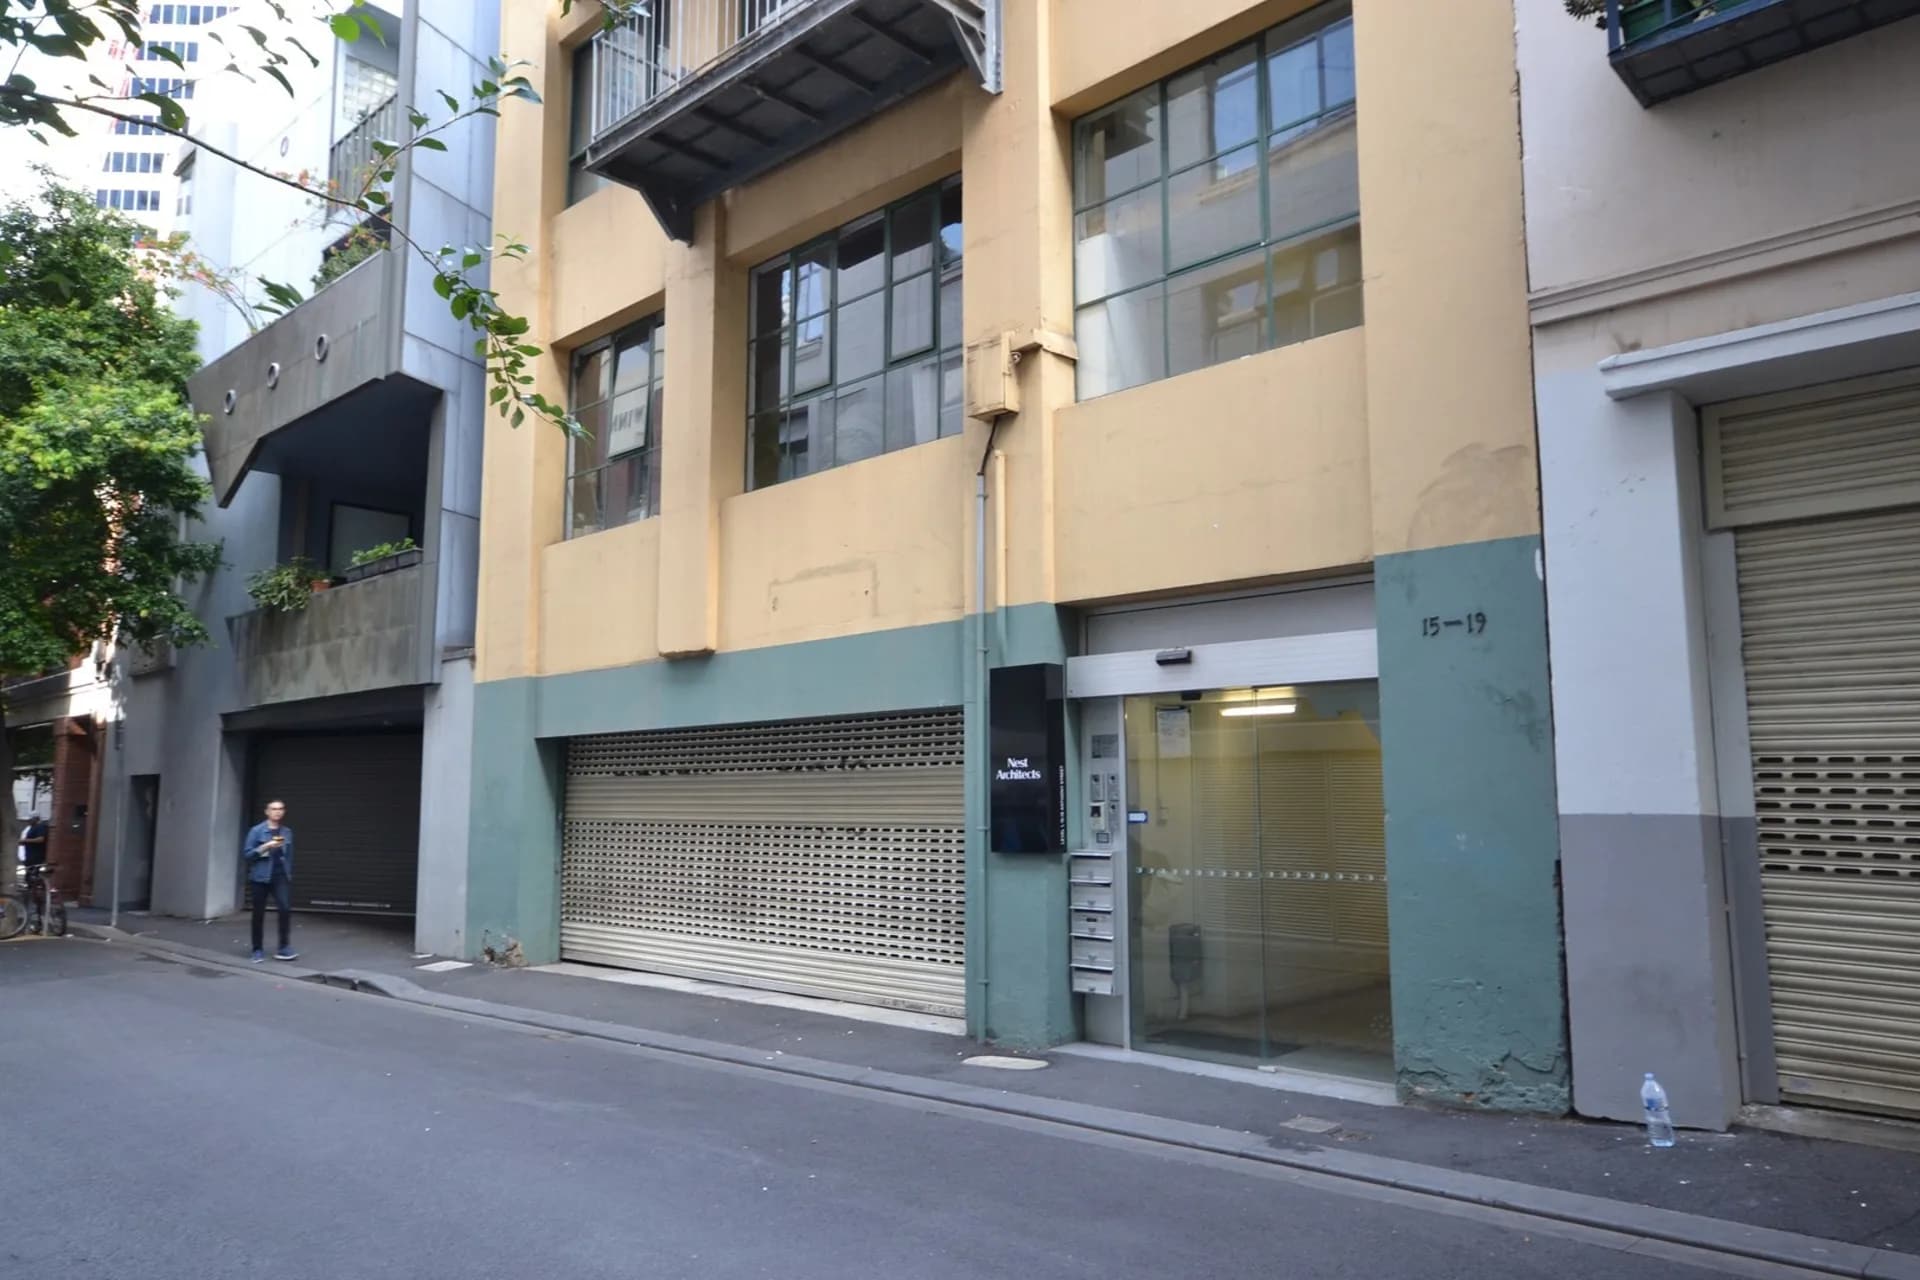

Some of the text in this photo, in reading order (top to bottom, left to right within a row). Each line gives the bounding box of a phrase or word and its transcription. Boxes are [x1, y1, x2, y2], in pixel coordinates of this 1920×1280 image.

[1422, 612, 1487, 637] 15-19
[1007, 757, 1029, 768] Nest
[996, 769, 1041, 780] Architects
